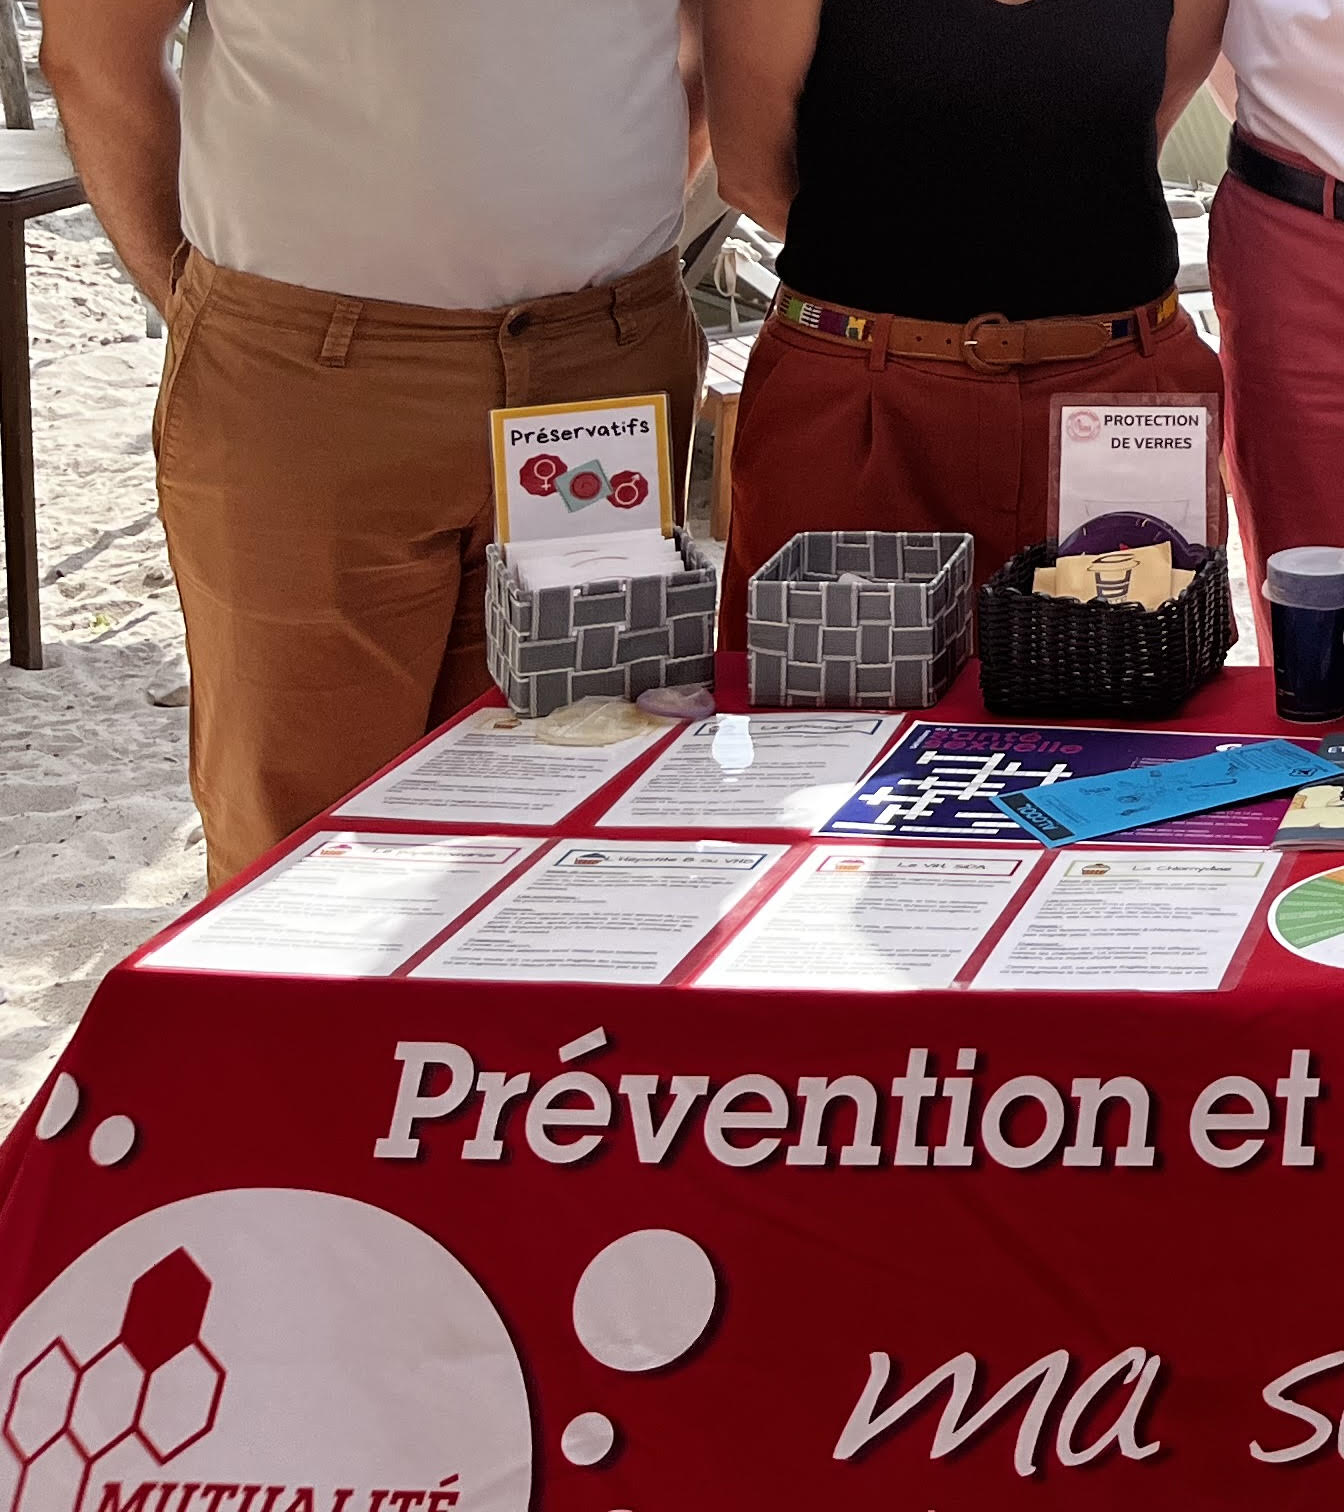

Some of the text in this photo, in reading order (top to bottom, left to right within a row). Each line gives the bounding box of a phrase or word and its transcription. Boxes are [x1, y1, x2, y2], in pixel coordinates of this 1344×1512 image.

[1104, 414, 1199, 427] PROTECTION
[510, 418, 650, 446] Préservatifs
[1111, 437, 1192, 450] DE VERRES
[922, 740, 1083, 755] sexuelle
[374, 1026, 1156, 1169] Prévention
[1189, 1049, 1316, 1170] et
[833, 1346, 1162, 1477] ma
